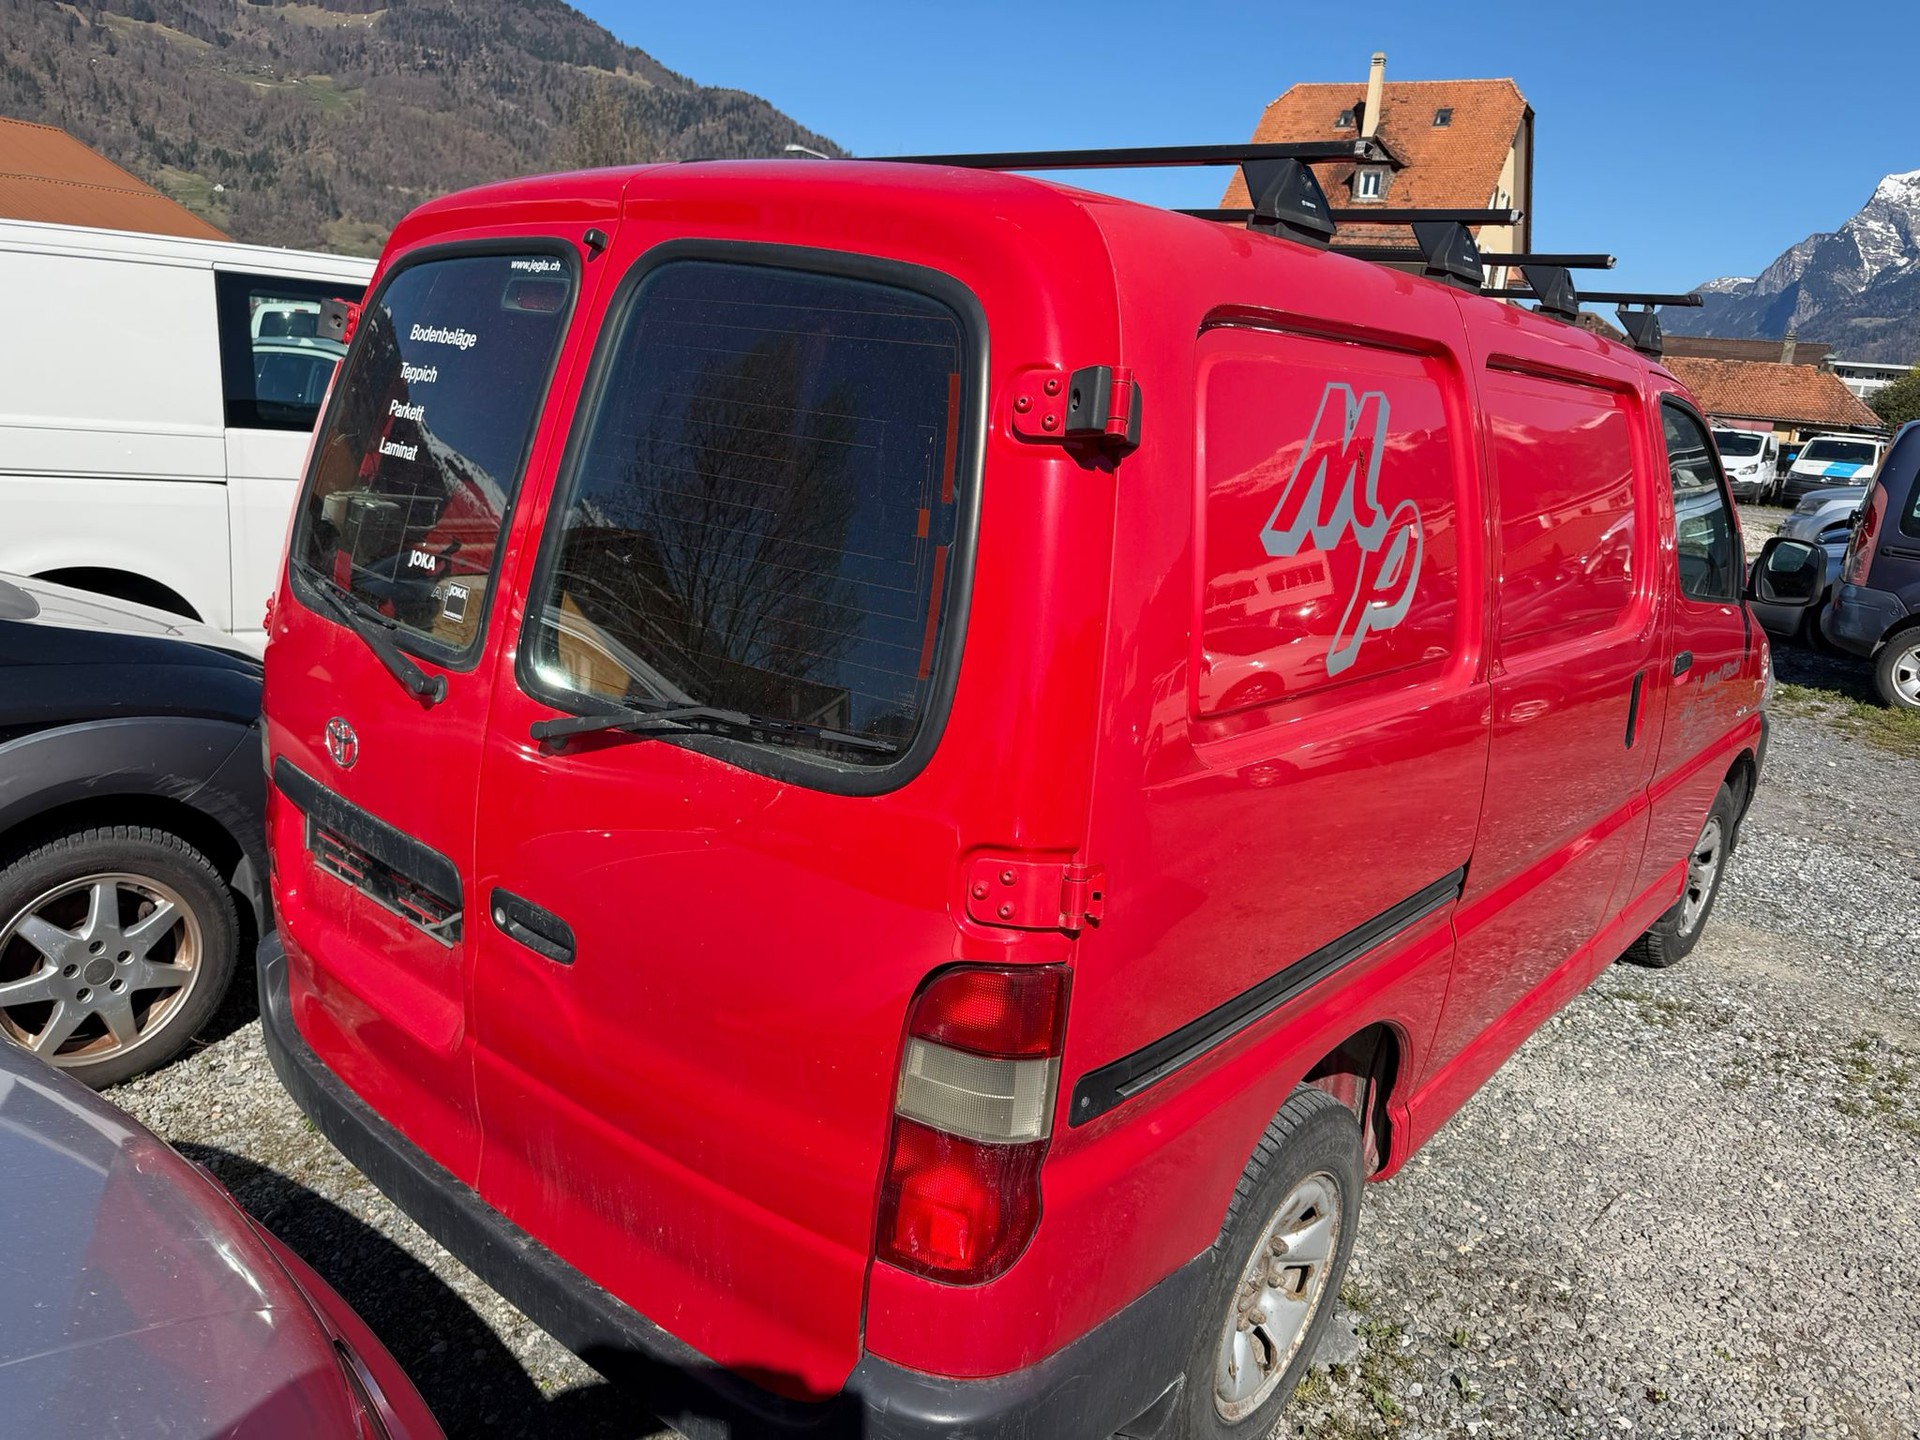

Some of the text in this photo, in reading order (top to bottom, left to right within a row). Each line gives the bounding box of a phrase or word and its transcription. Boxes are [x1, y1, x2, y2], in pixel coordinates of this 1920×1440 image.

[510, 259, 561, 273] www.jegla.ch
[410, 323, 477, 350] Bodenbeläge
[400, 361, 438, 384] Teppich
[388, 399, 425, 422] Parkett
[379, 436, 418, 462] Laminat
[408, 549, 436, 571] JOKA
[448, 584, 468, 600] JOKA
